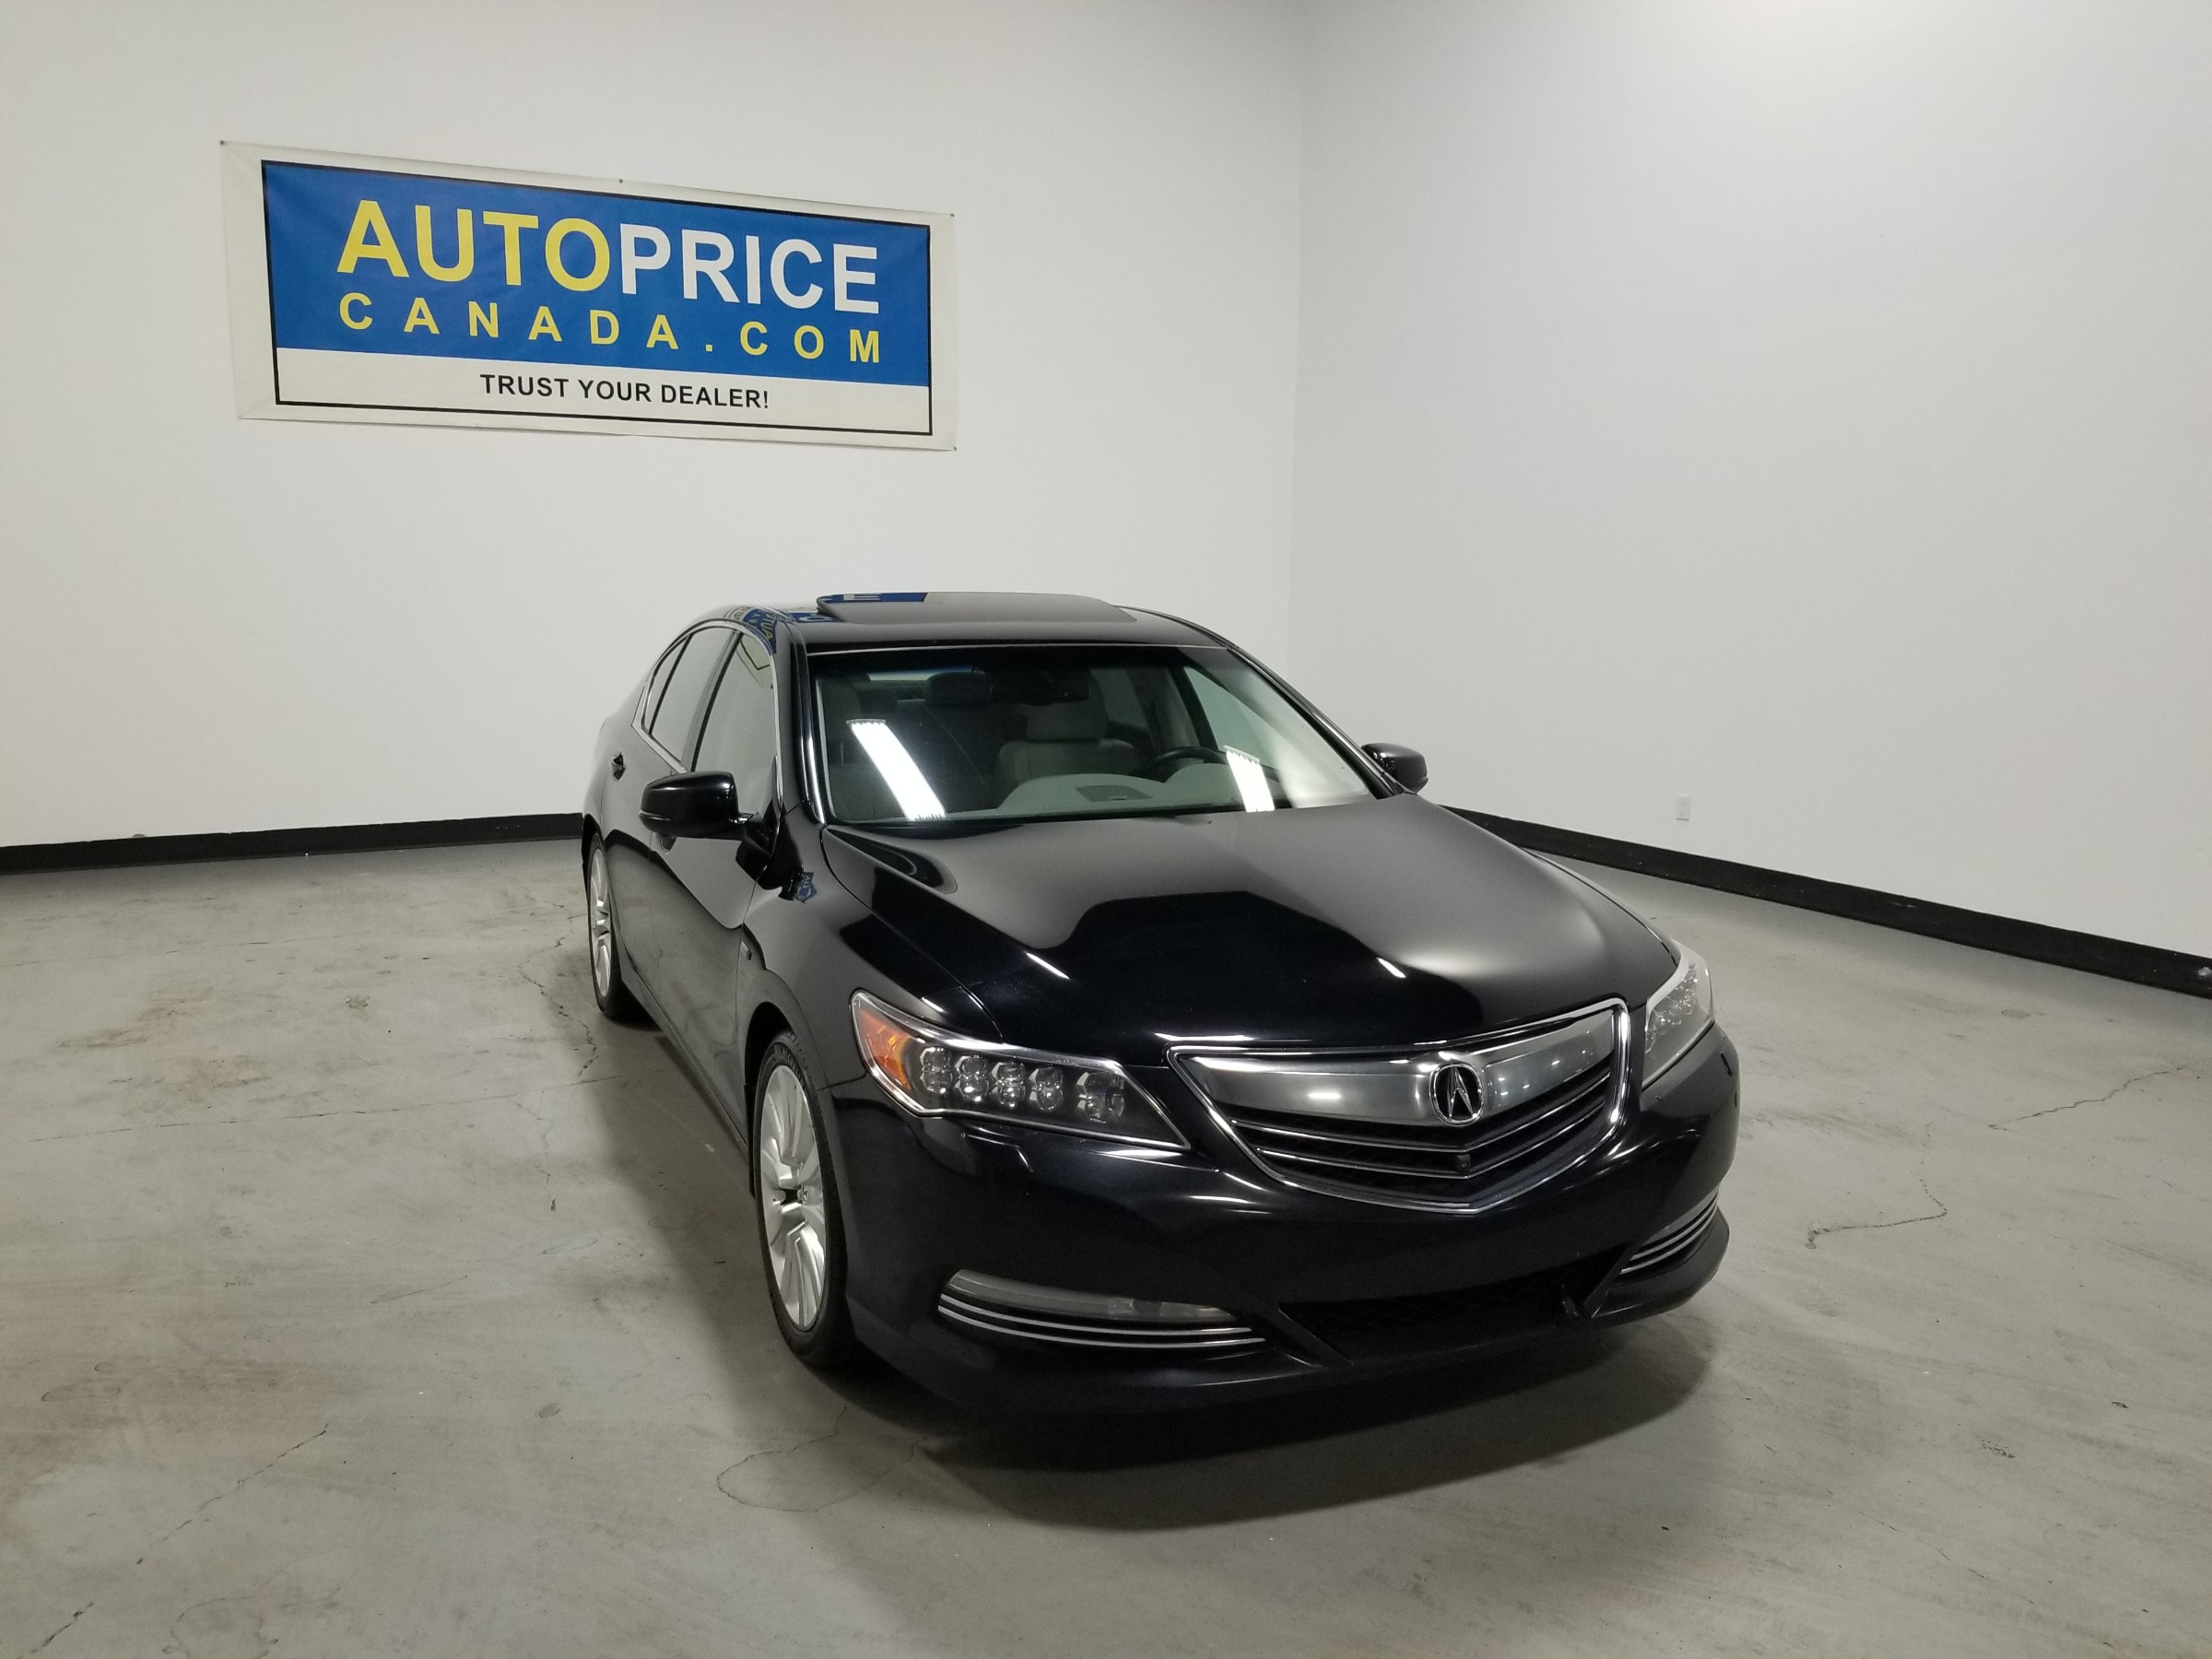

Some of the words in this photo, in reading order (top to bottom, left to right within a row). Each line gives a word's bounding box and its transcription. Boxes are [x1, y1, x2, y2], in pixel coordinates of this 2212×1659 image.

[336, 199, 880, 314] AUTOPRICE
[339, 292, 880, 364] CANADA.COM
[480, 373, 570, 397] TRUST
[578, 379, 652, 403] YOUR
[661, 384, 768, 408] DEALER!
